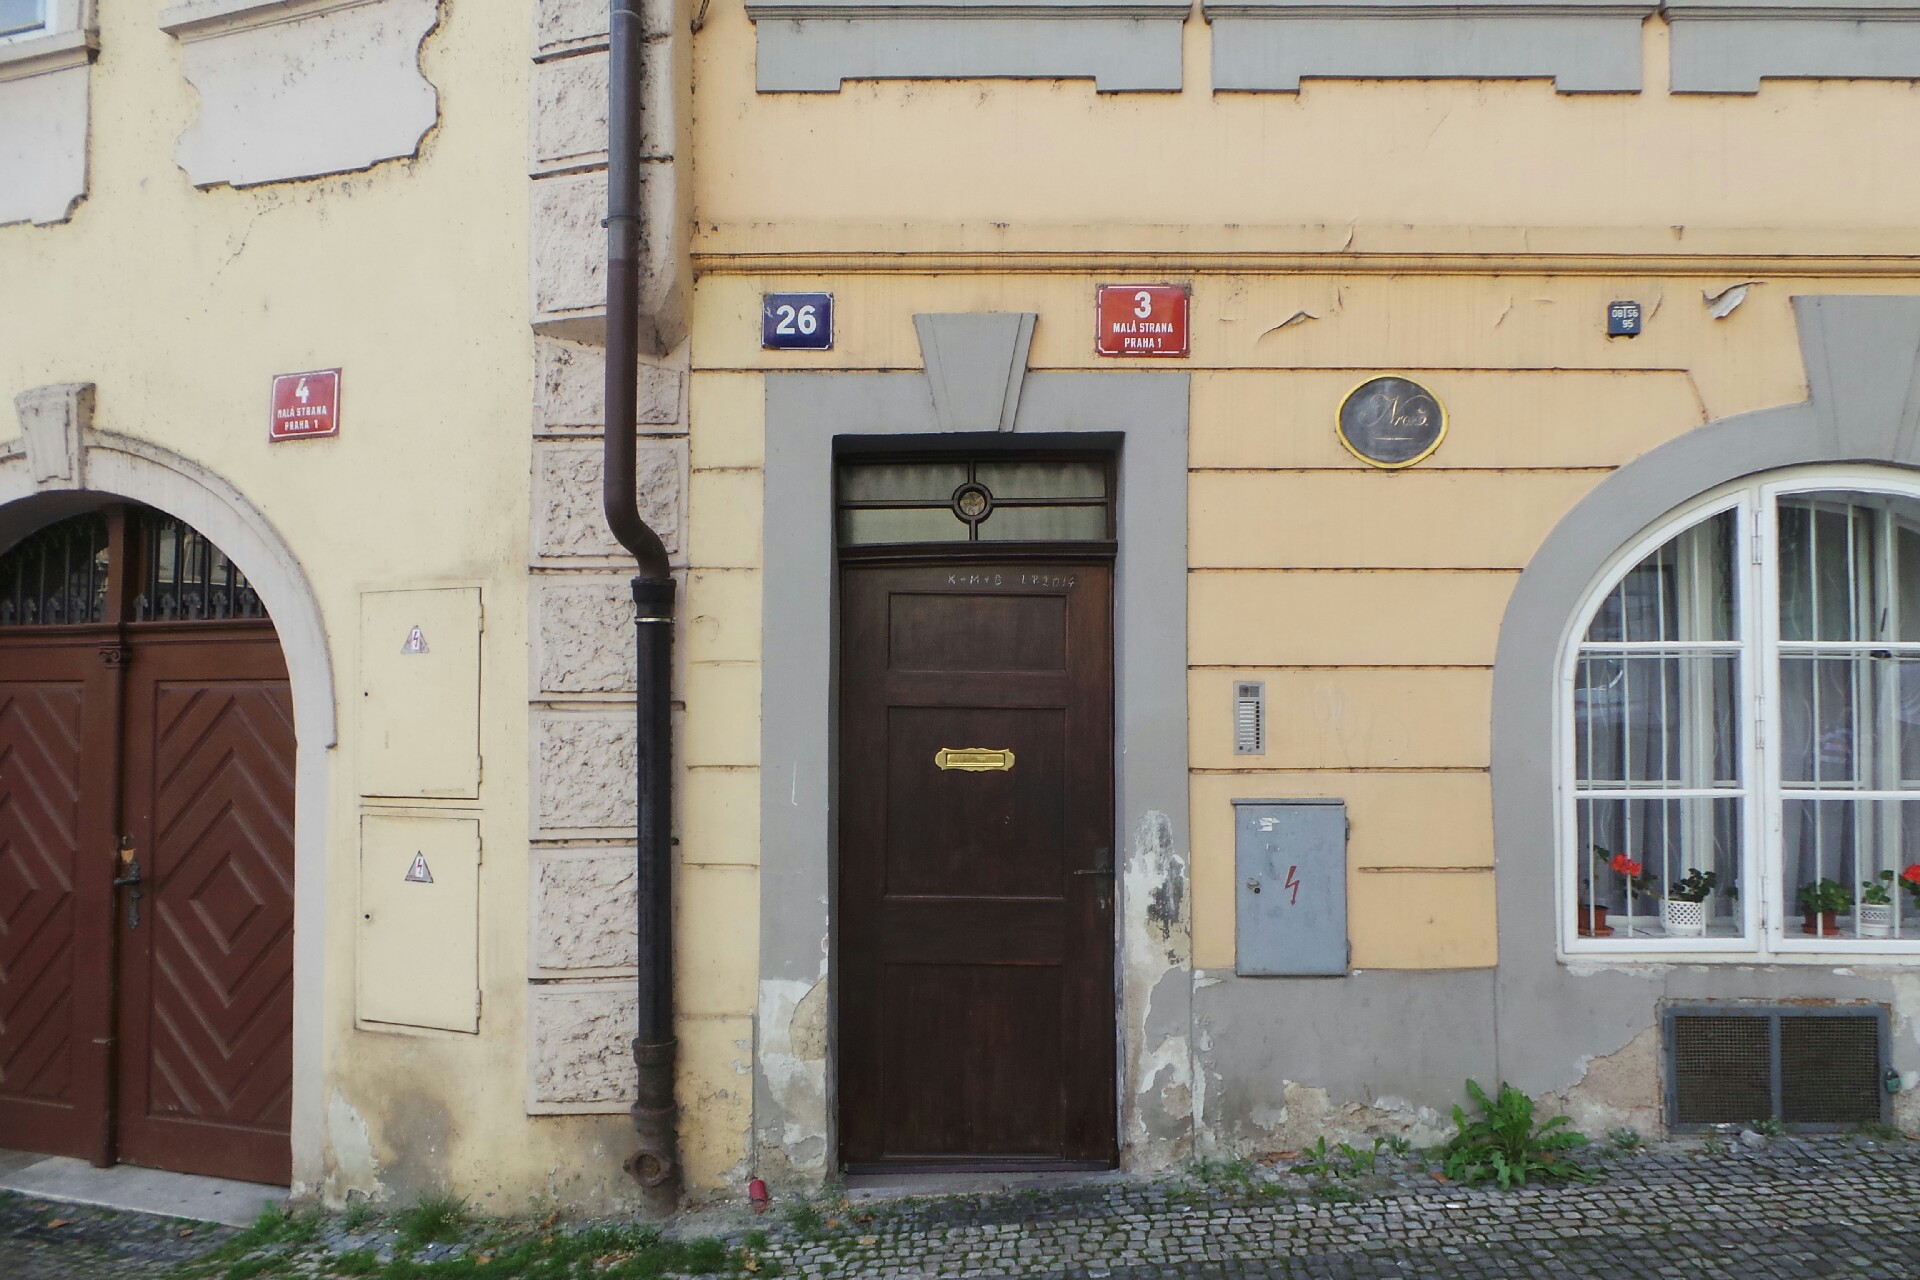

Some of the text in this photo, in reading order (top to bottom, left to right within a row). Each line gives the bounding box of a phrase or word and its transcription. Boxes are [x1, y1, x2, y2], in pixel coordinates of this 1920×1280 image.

[1134, 290, 1152, 319] 3
[776, 305, 817, 335] 26
[1113, 320, 1174, 333] MALÁ STRANA
[1124, 337, 1162, 348] PRAHA 1
[295, 377, 309, 404] 4
[277, 405, 327, 419] MALÁ STRANA
[284, 419, 319, 431] PRAHA 1
